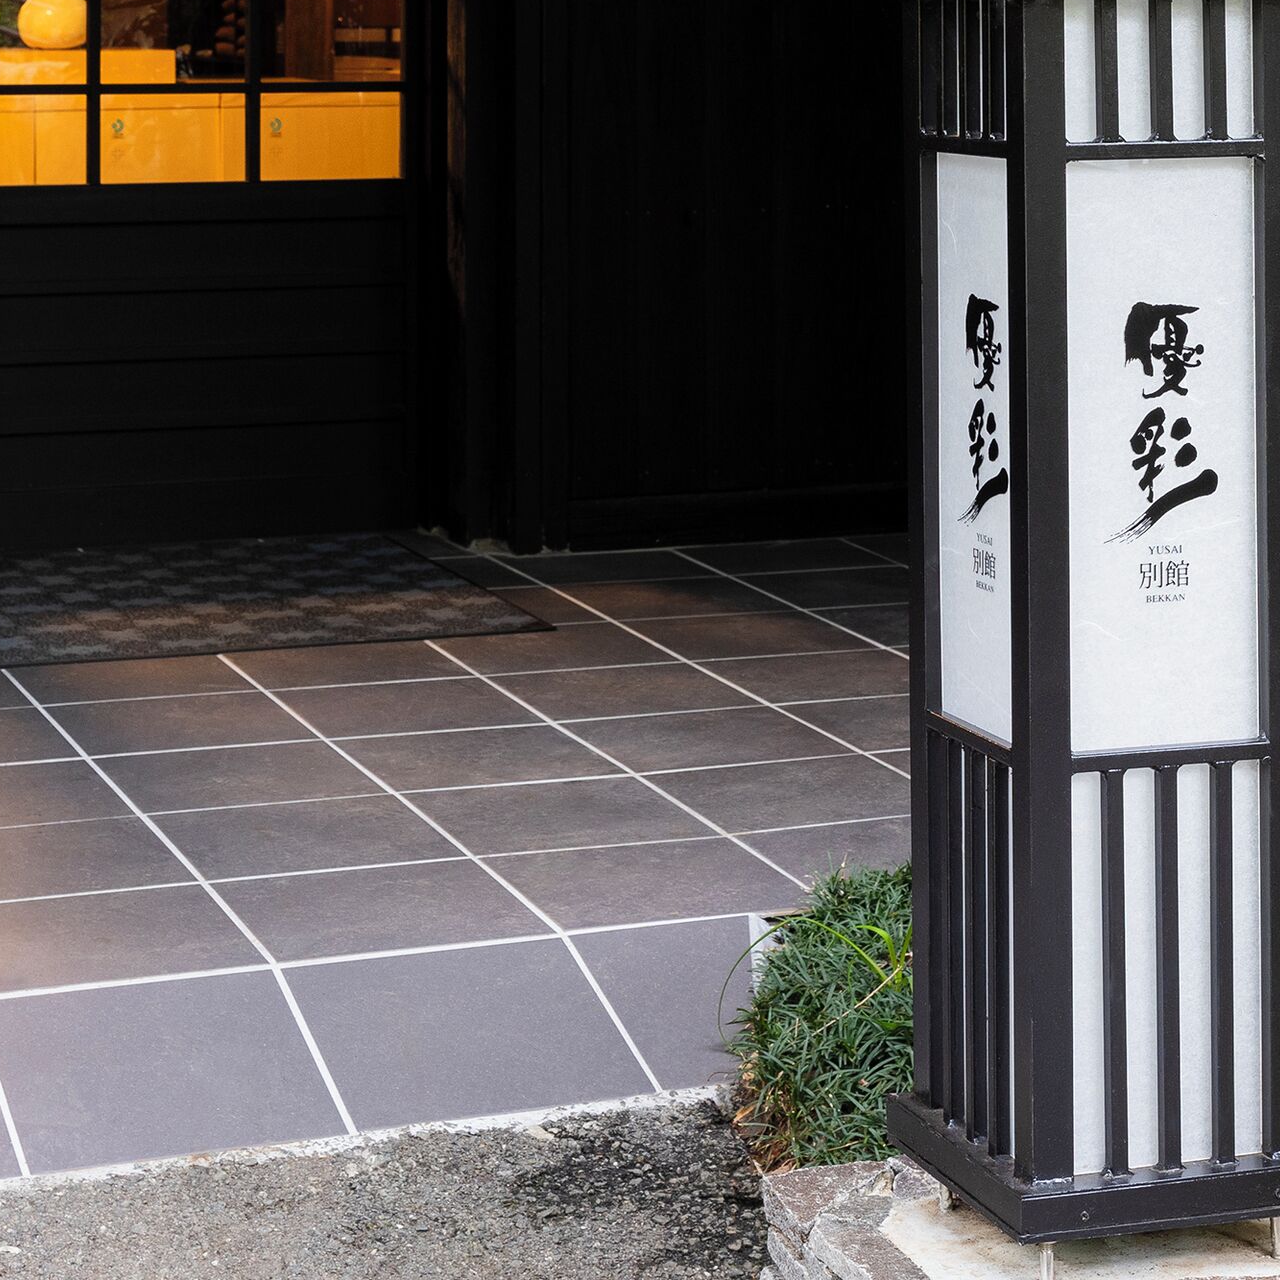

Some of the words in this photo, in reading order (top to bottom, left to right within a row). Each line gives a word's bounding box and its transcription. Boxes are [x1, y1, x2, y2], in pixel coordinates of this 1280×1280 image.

[957, 294, 1009, 527] 優彩
[1104, 301, 1218, 544] 優彩
[976, 532, 993, 546] YUSAI
[1148, 544, 1183, 555] YUSAI
[972, 547, 996, 580] 別館
[1139, 559, 1190, 589] 別館
[1145, 593, 1186, 603] BEKKAN
